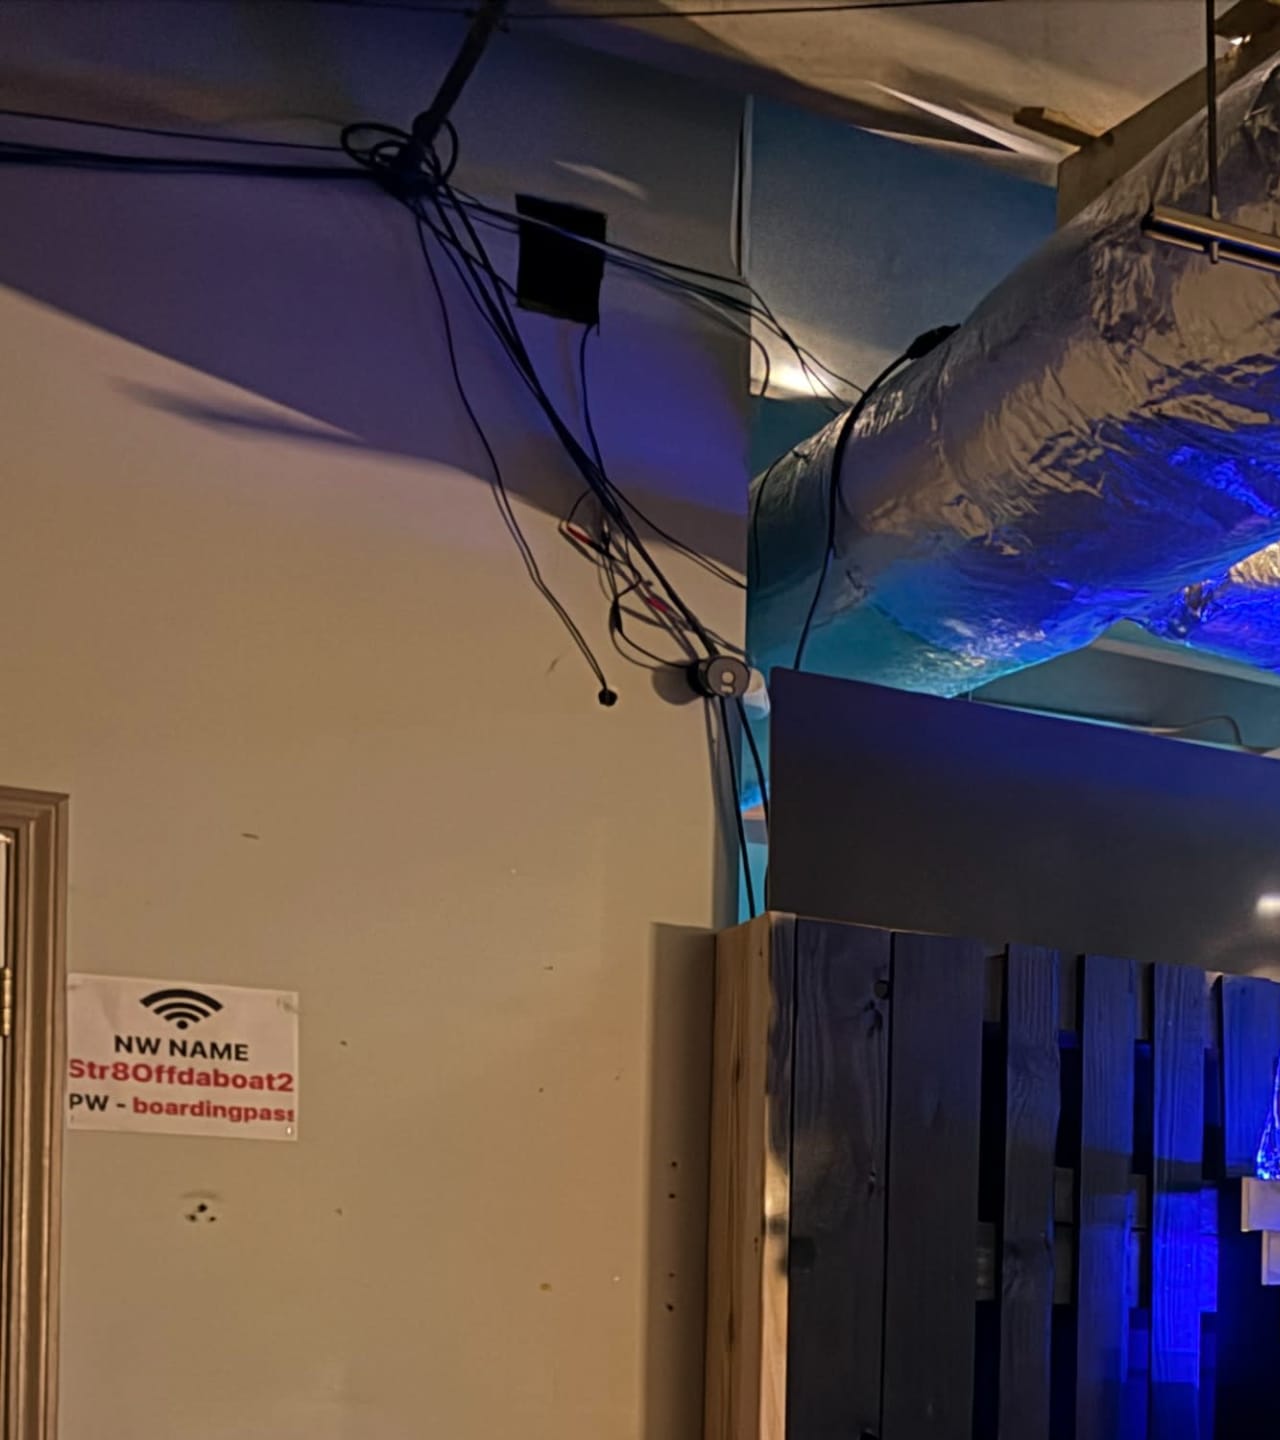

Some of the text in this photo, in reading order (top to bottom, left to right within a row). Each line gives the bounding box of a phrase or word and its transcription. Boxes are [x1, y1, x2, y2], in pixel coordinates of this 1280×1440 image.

[114, 1034, 249, 1061] NW NAME
[69, 1058, 294, 1092] Str8Offdaboat2
[69, 1093, 109, 1112] PW
